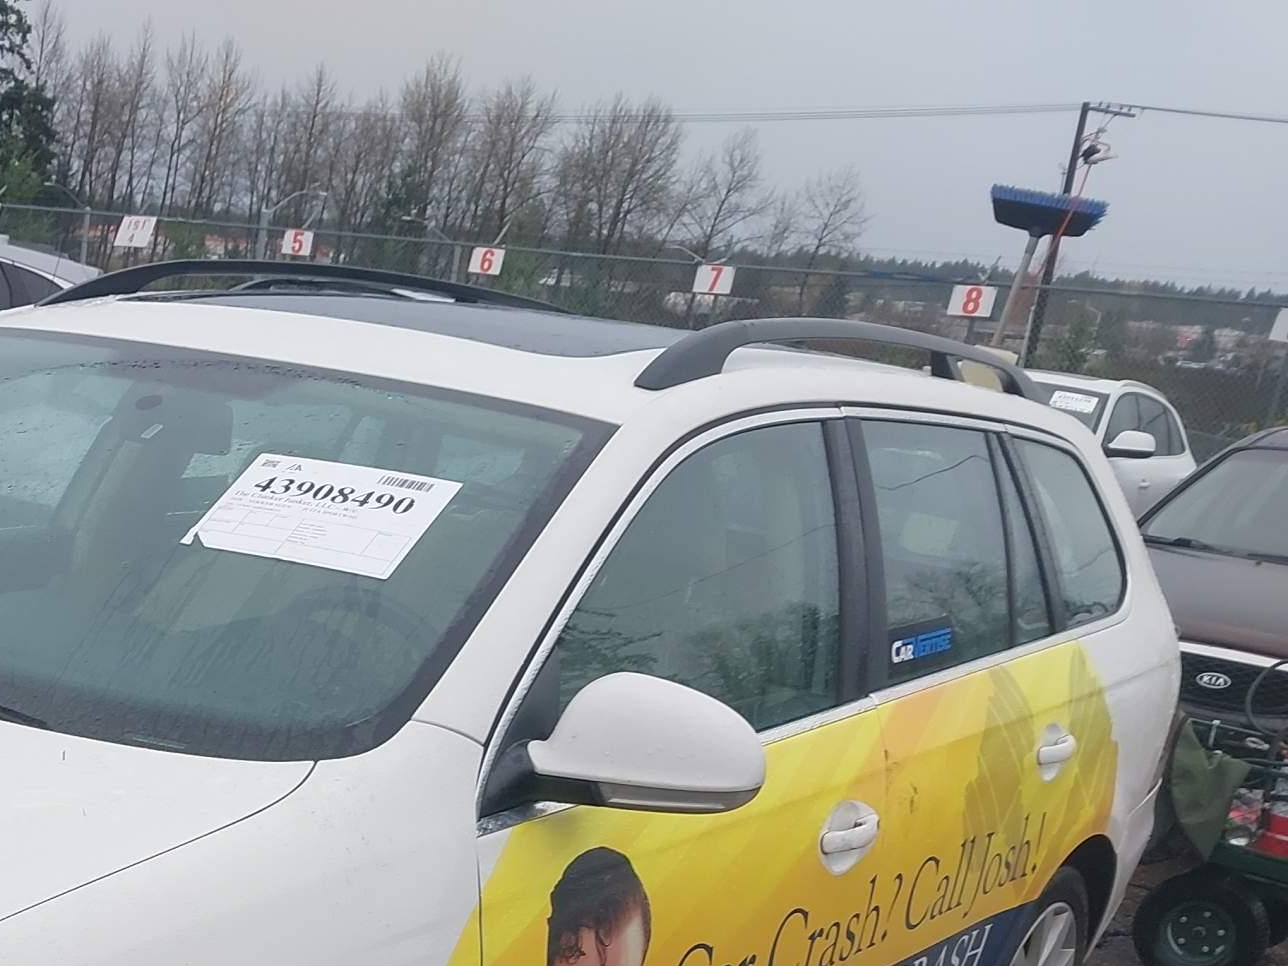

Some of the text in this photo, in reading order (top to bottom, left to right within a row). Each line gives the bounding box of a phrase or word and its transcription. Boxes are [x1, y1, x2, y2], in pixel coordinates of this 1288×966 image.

[291, 231, 304, 255] 5
[479, 249, 494, 273] 6
[707, 266, 724, 292] 7
[961, 287, 983, 315] 8
[254, 475, 416, 515] 43908490
[1202, 674, 1225, 687] KIA
[904, 837, 976, 930] Call
[963, 812, 1047, 919] Josh!
